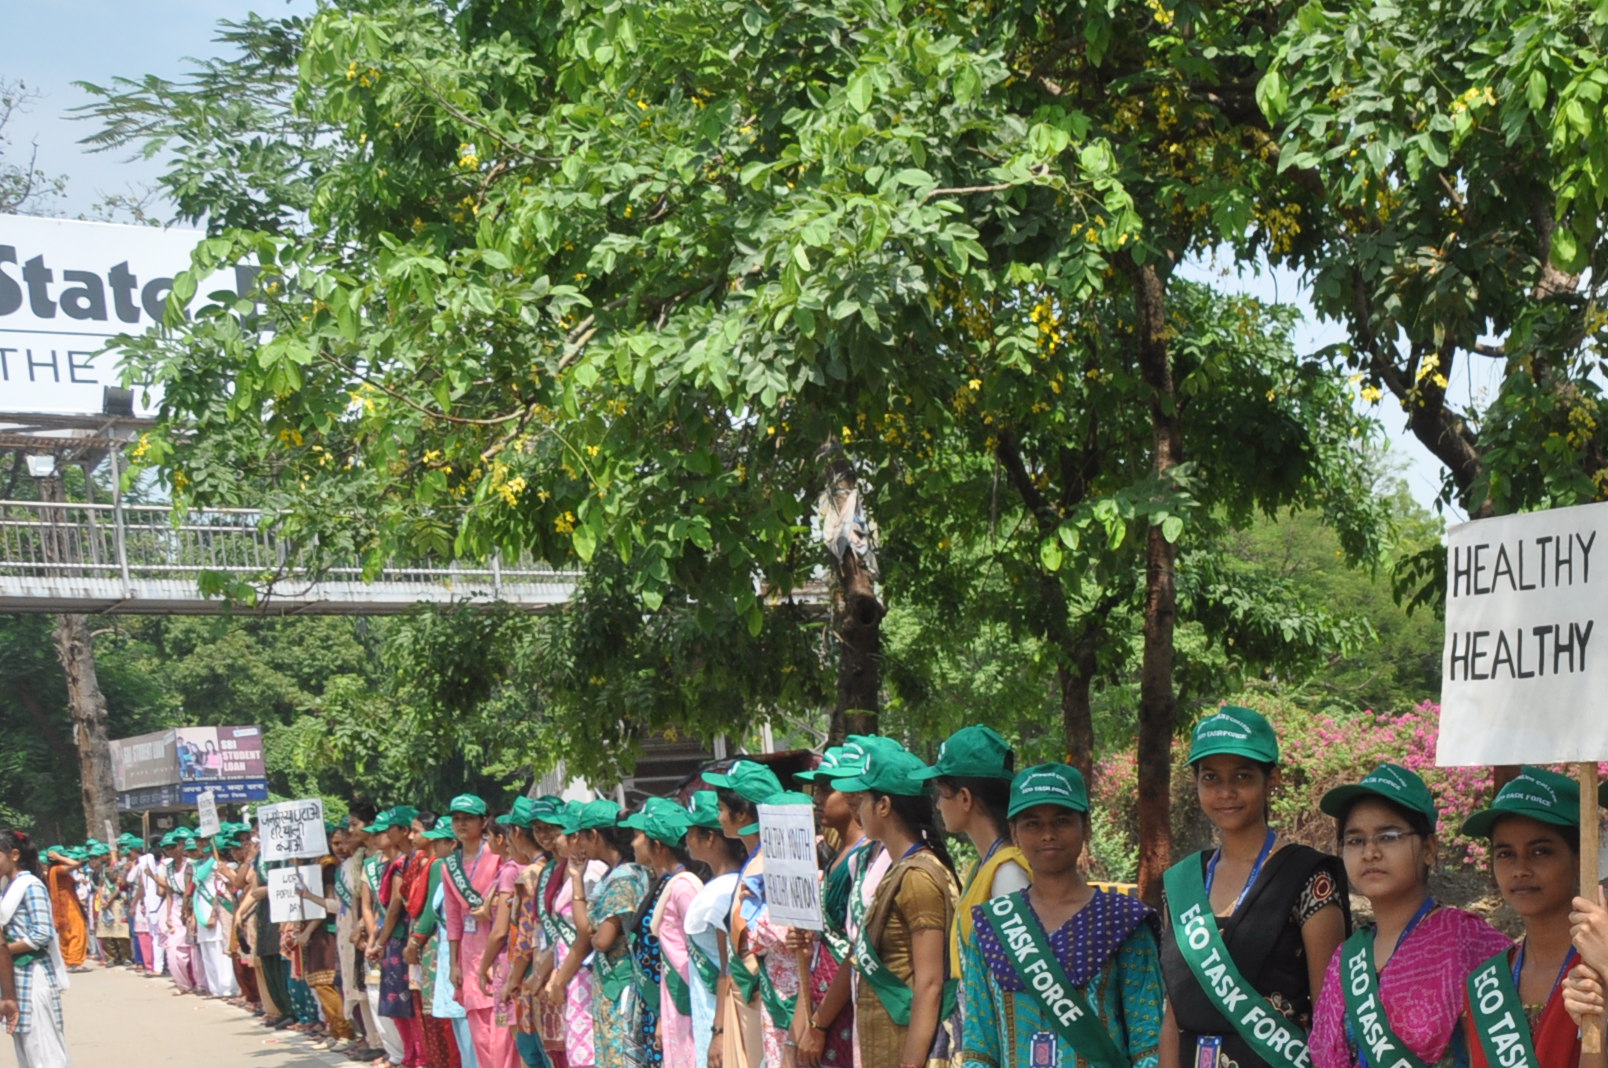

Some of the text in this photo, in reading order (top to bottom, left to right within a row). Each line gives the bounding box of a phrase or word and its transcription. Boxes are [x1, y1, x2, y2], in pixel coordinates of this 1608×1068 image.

[1453, 530, 1596, 598] HEALTHY
[1450, 620, 1594, 681] HEALTHY
[222, 750, 261, 760] STUDENT
[1525, 793, 1551, 807] FORCE
[788, 828, 812, 861] YOUTH
[789, 876, 817, 910] NATION
[541, 915, 561, 943] FORC
[1000, 912, 1039, 963] TASK
[1023, 959, 1084, 1027] FORCE
[1179, 903, 1210, 950] ECO
[1200, 947, 1248, 1013] TASK
[1349, 947, 1370, 997] ECO
[1474, 965, 1504, 1015] ECO
[1356, 993, 1395, 1063] TASK
